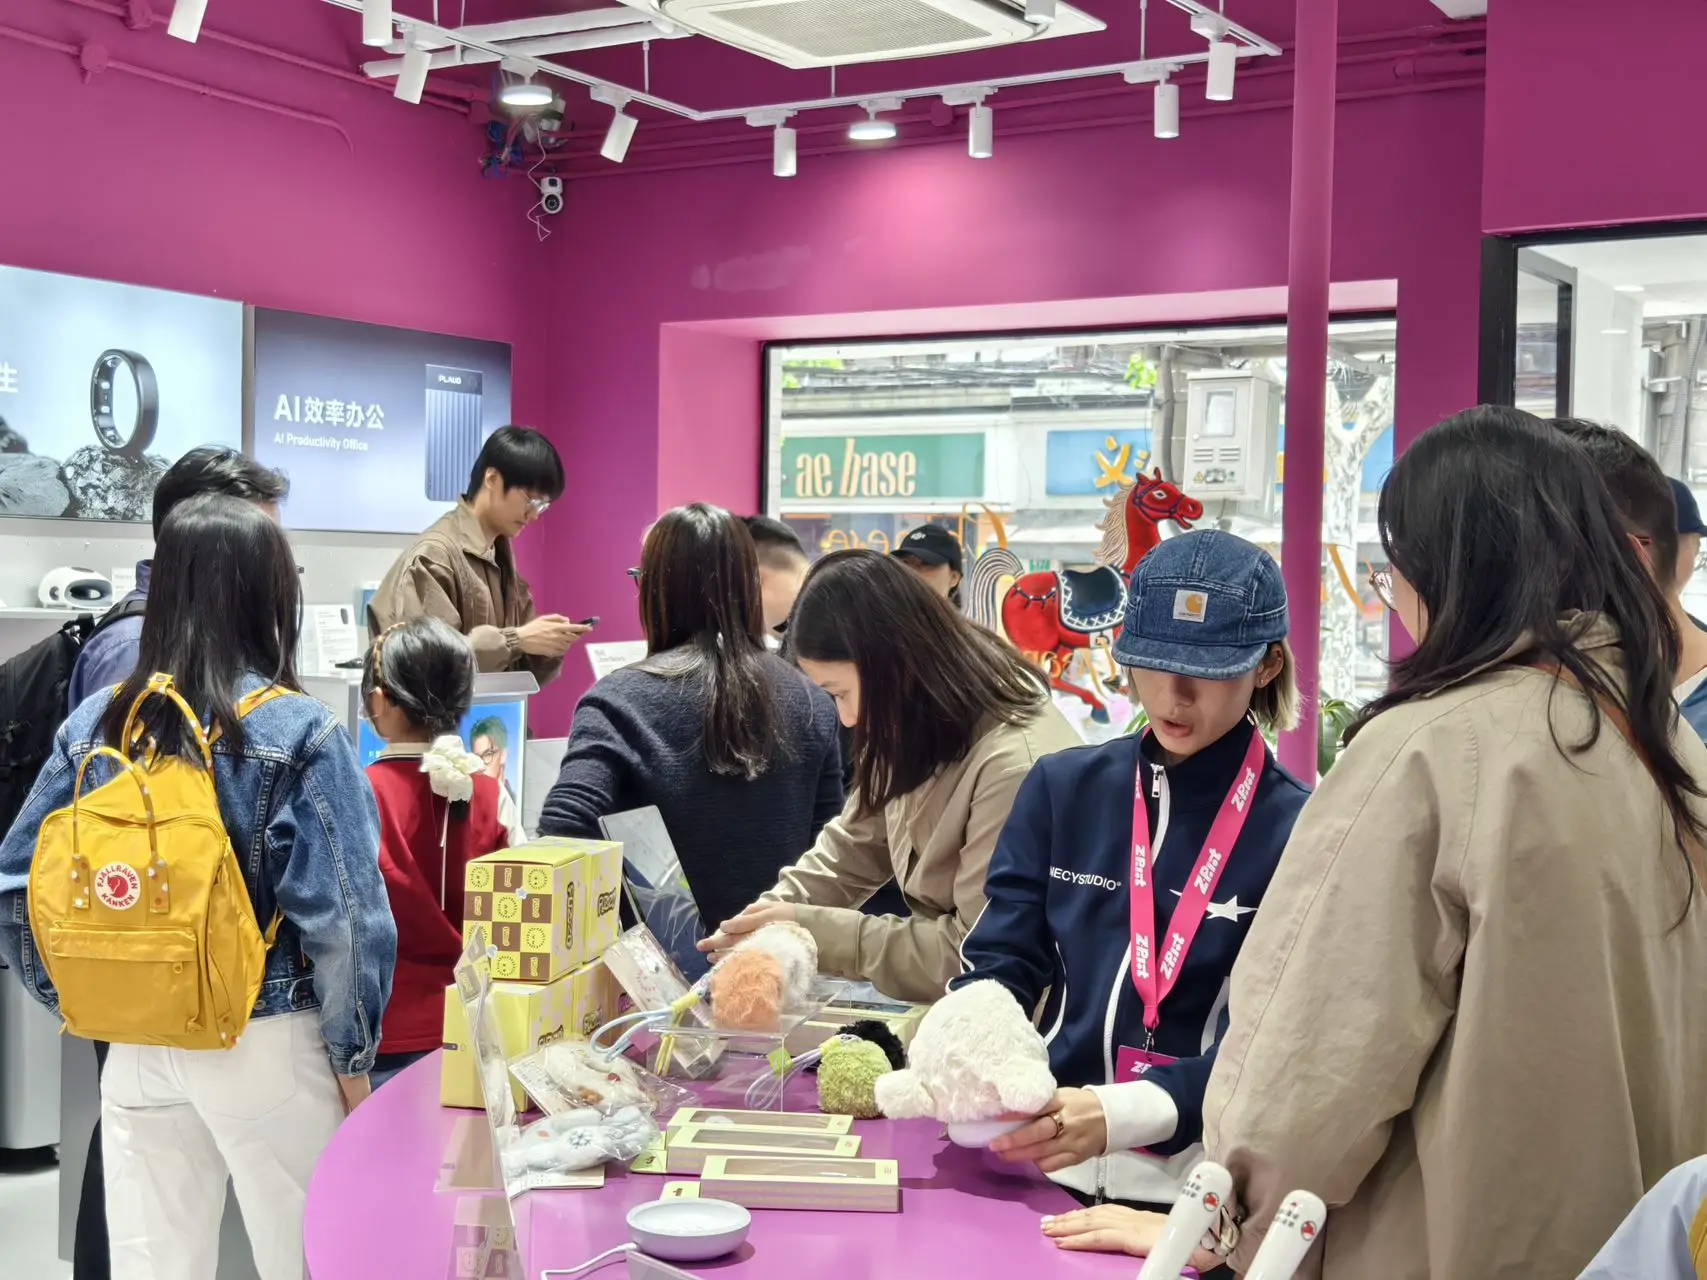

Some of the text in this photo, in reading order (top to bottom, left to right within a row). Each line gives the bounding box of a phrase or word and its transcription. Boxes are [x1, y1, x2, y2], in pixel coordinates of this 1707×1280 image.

[274, 432, 368, 452] AI Productivity Office
[795, 437, 917, 497] ae base
